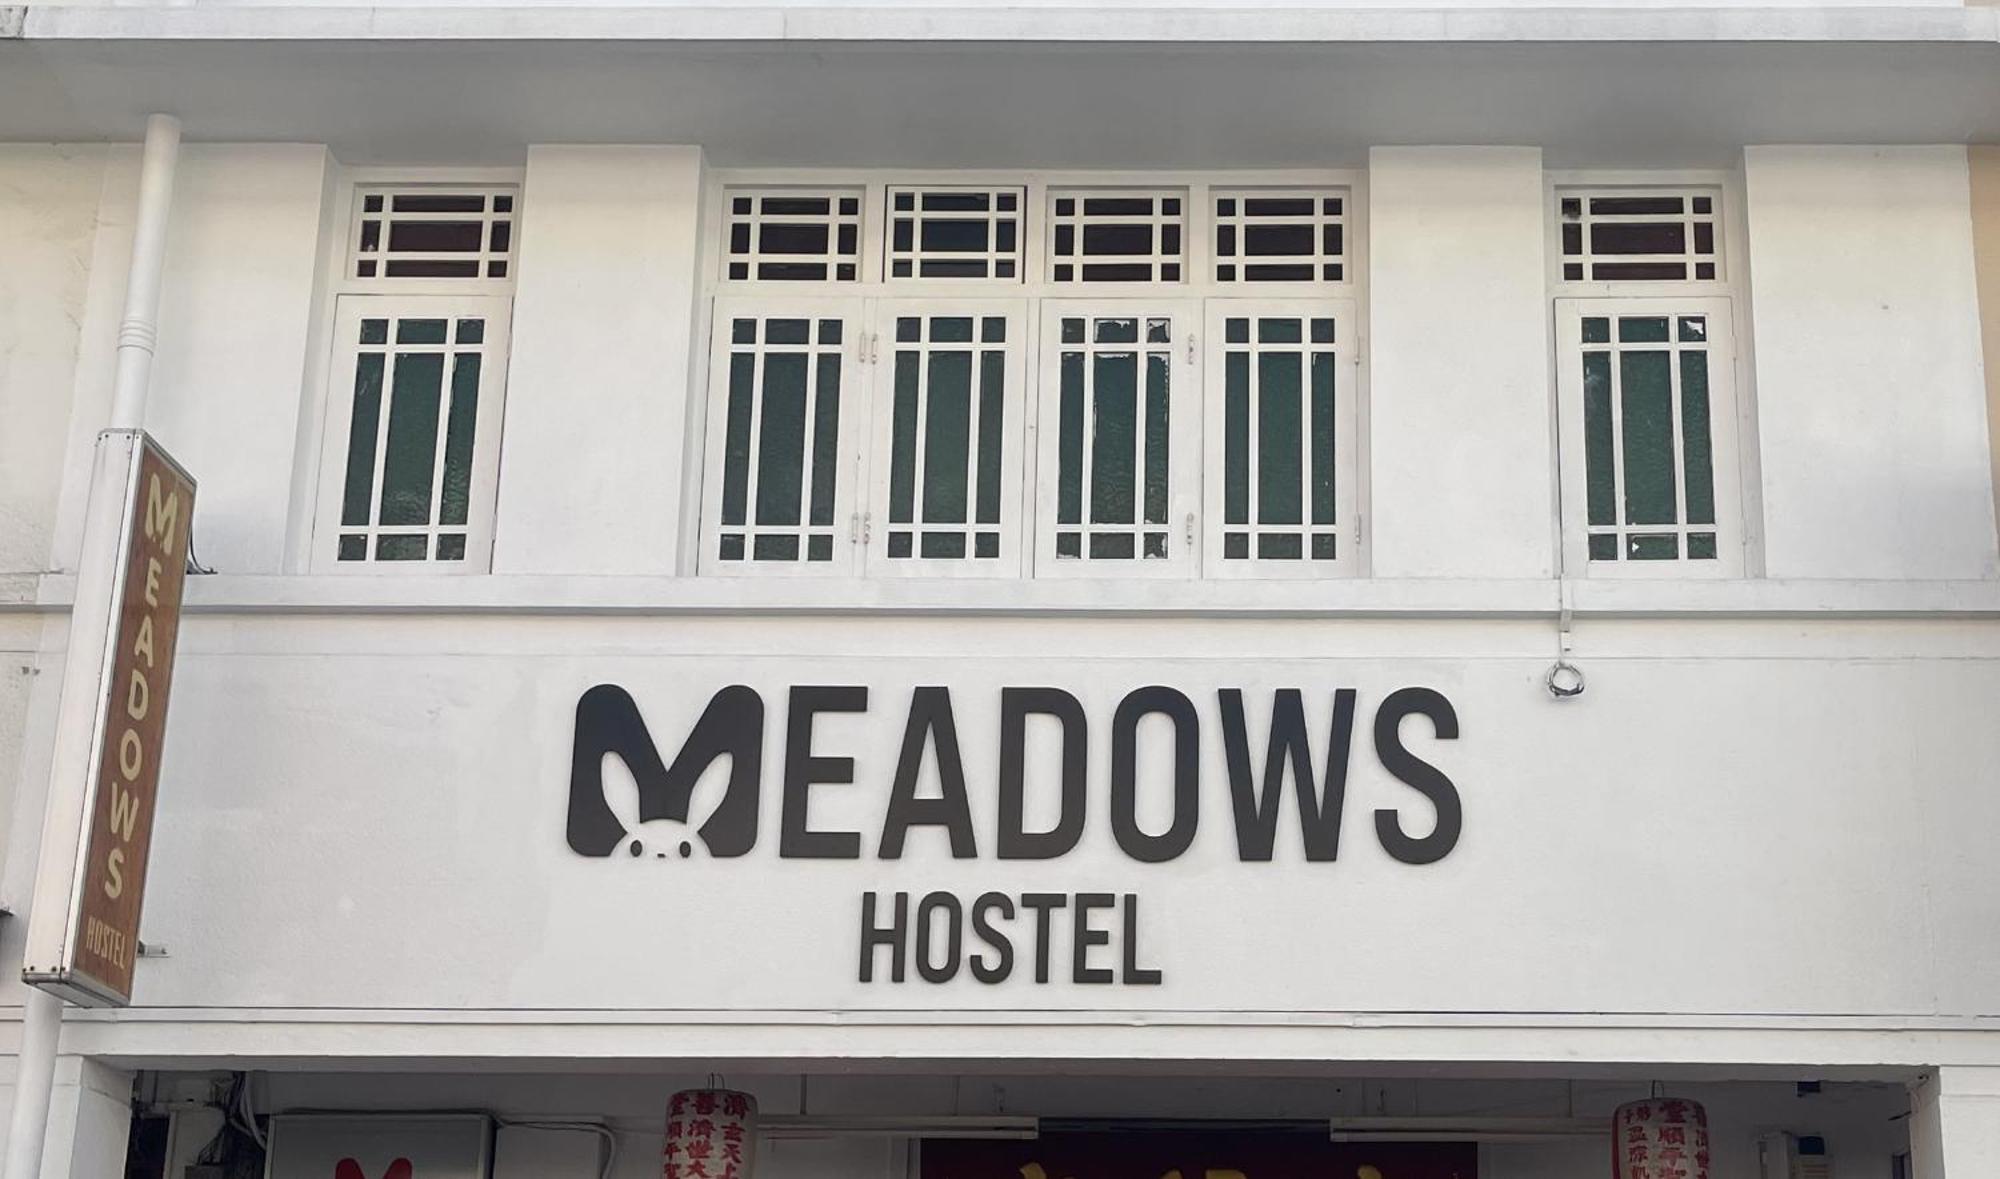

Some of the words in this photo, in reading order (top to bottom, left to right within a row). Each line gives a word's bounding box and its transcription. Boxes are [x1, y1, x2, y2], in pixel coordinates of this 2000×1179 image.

[104, 473, 179, 899] MEADOWS
[566, 684, 1462, 865] MEADOWS
[86, 916, 126, 970] HOSTEL
[858, 891, 1162, 985] HOSTEL
